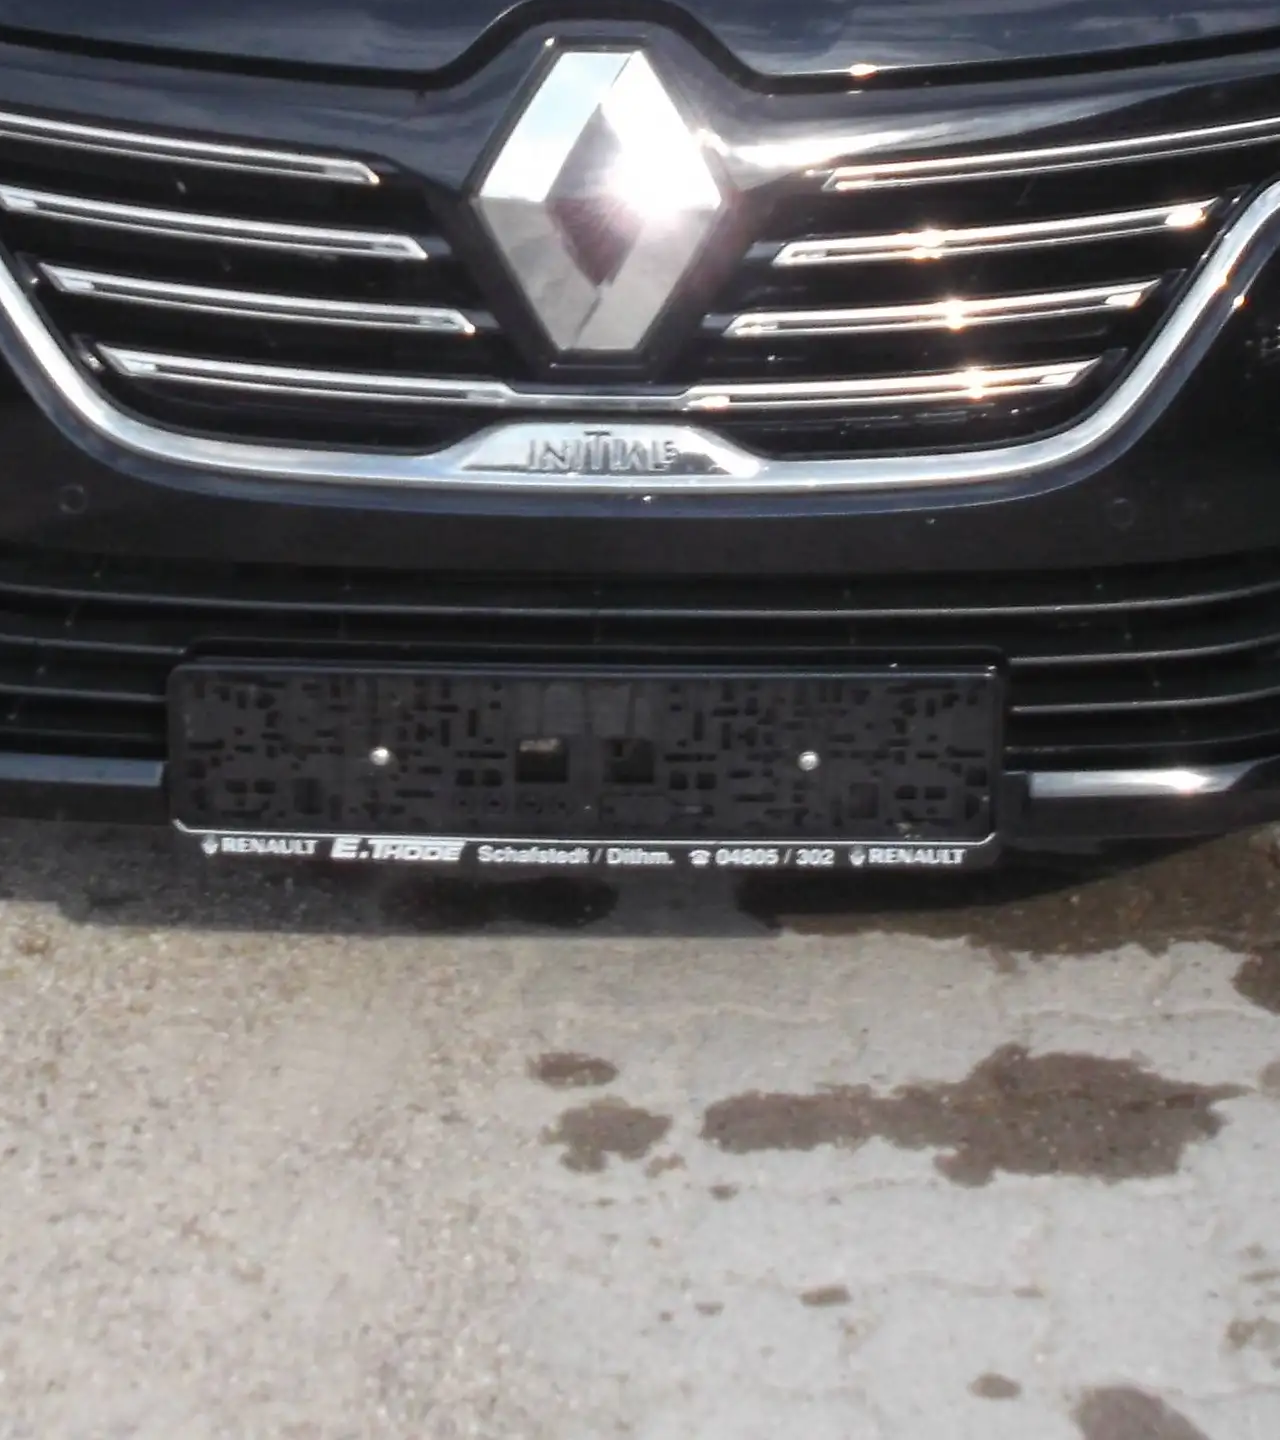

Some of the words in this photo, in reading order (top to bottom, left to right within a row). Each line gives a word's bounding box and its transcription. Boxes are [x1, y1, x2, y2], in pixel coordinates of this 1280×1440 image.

[220, 836, 318, 855] RENAULT
[477, 845, 590, 864] Schafstedt
[606, 847, 675, 865] Dithm.
[715, 848, 779, 865] 04805
[795, 848, 835, 865] 302
[868, 847, 966, 865] RENAULT
